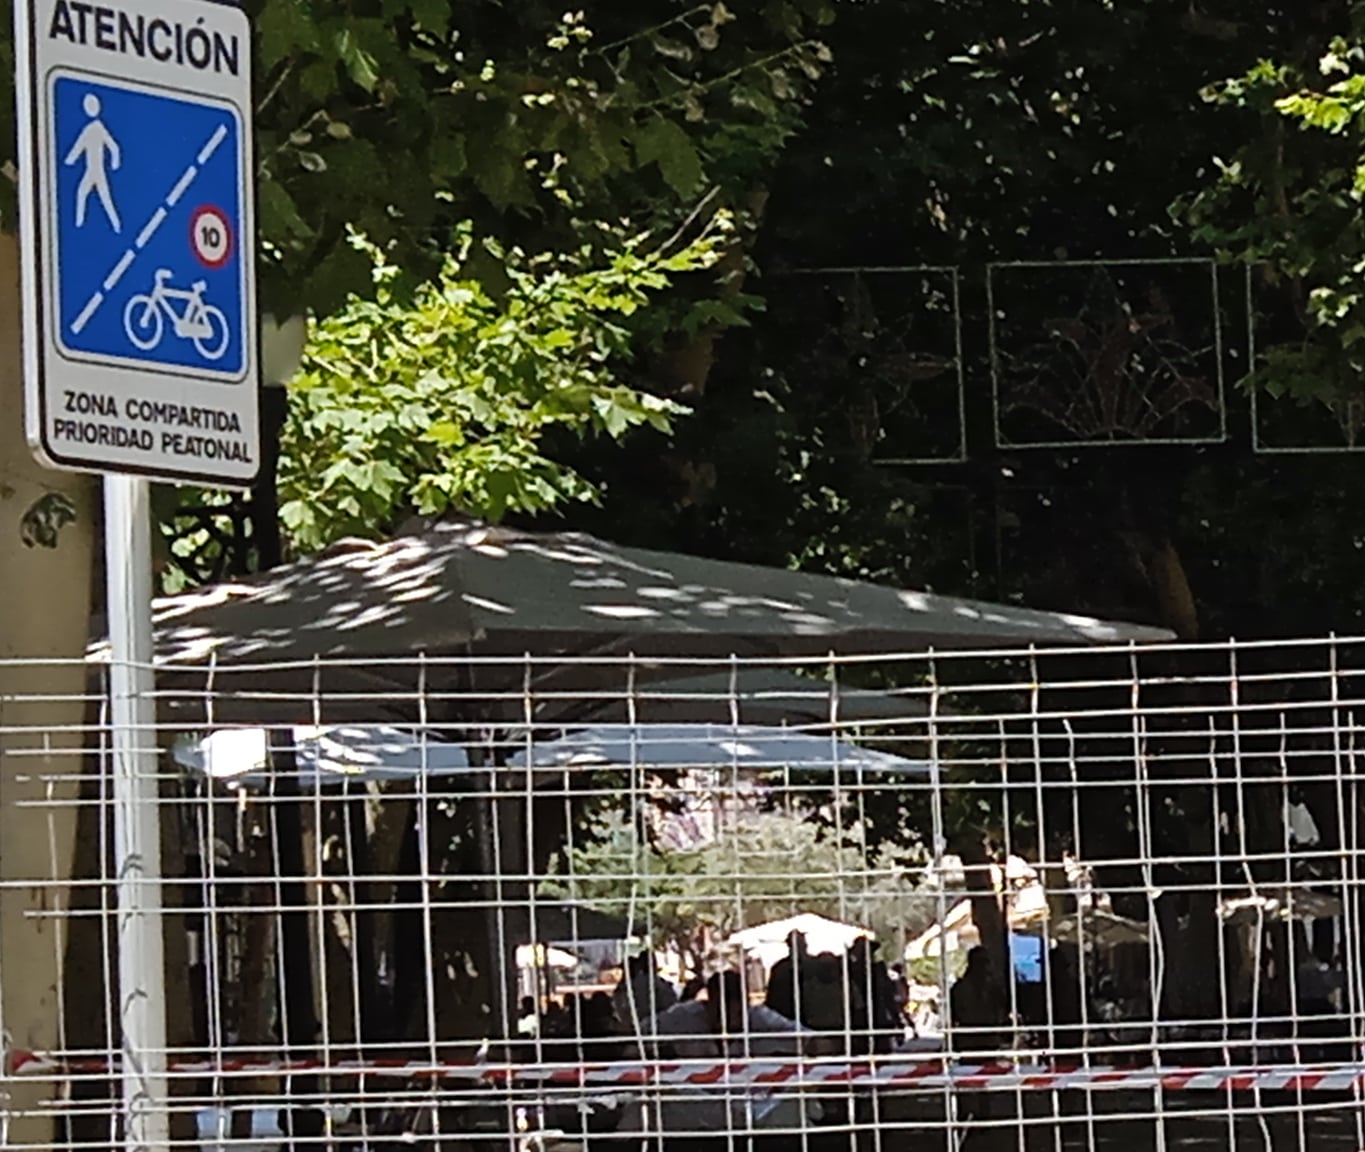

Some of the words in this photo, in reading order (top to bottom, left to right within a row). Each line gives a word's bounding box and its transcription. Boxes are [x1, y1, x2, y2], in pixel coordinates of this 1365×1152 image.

[50, 0, 239, 76] ATENCIÓN
[201, 226, 221, 249] 10
[64, 391, 118, 417] ZONA
[126, 399, 242, 434] COMPARTIDA
[54, 418, 154, 450] PRIORIDAD
[161, 432, 254, 464] PEATONAL
